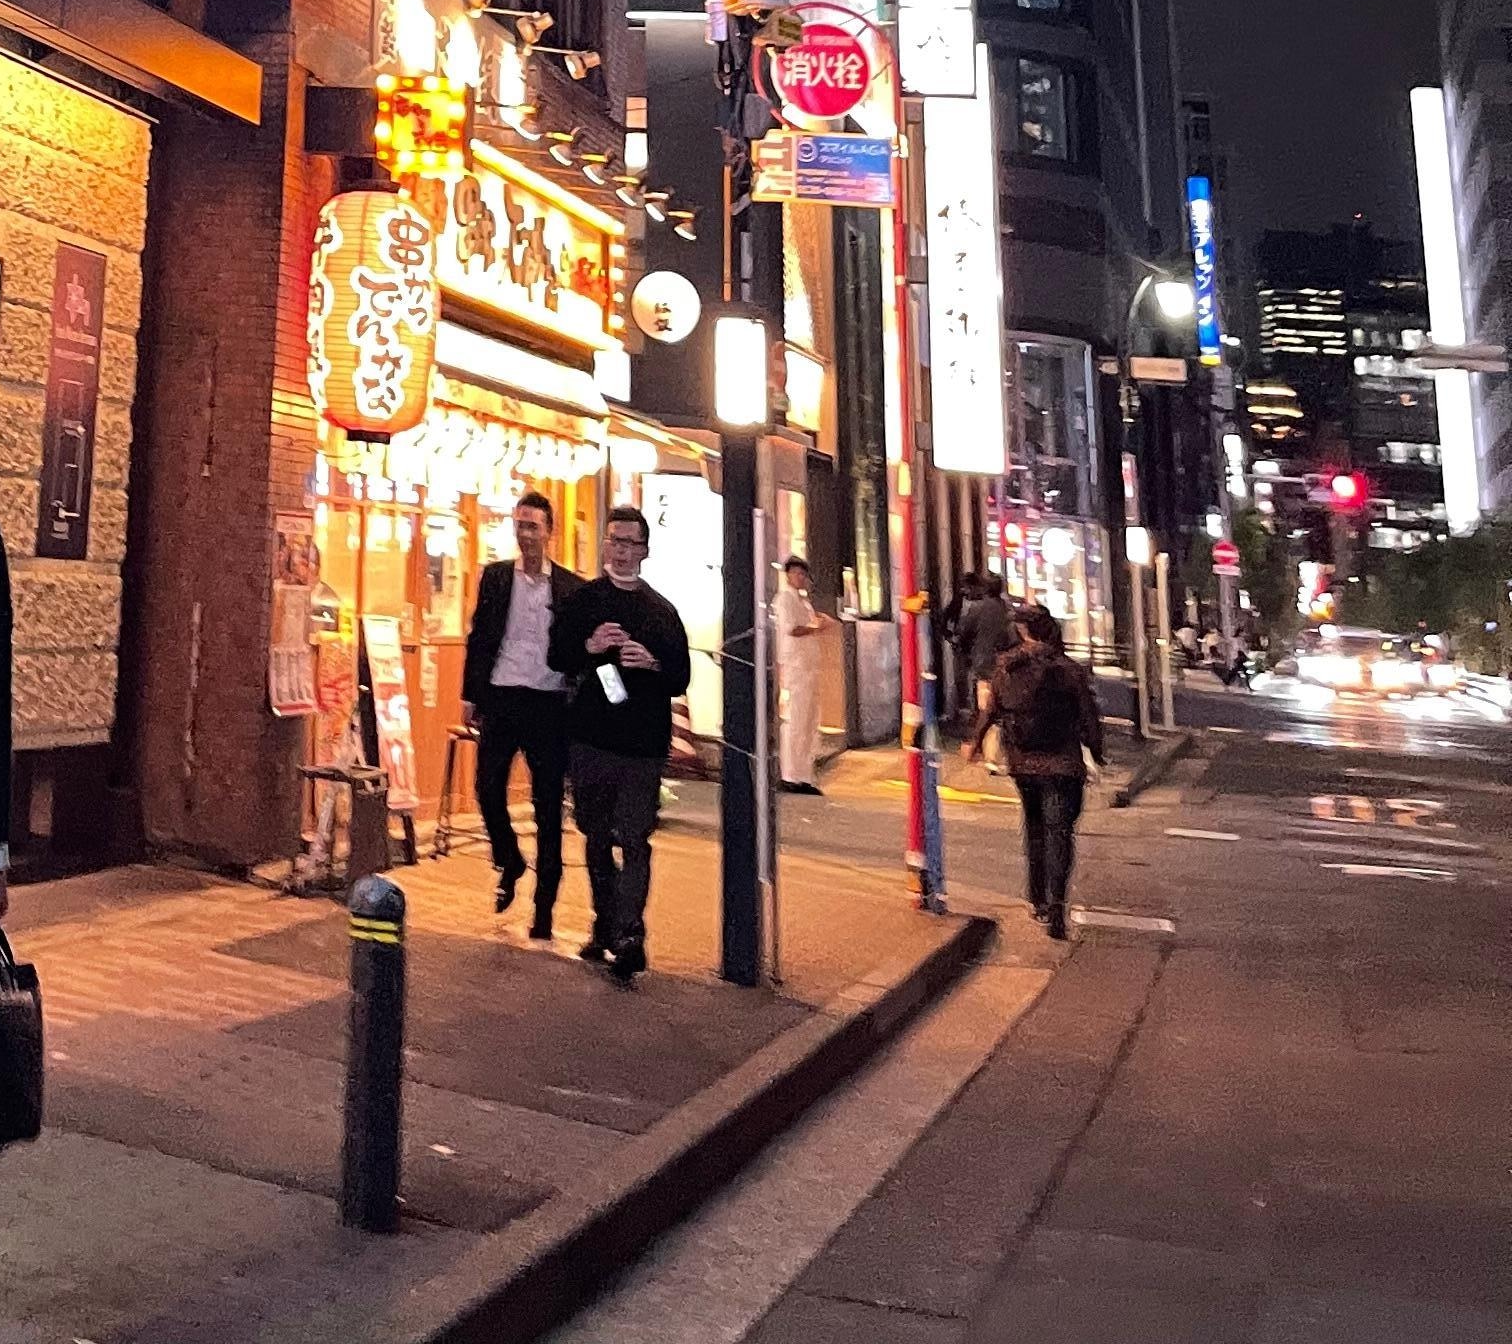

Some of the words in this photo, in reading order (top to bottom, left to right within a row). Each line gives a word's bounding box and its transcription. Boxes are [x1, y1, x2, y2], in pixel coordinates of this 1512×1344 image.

[783, 51, 864, 90] 消火栓
[387, 210, 431, 327] 串かつ
